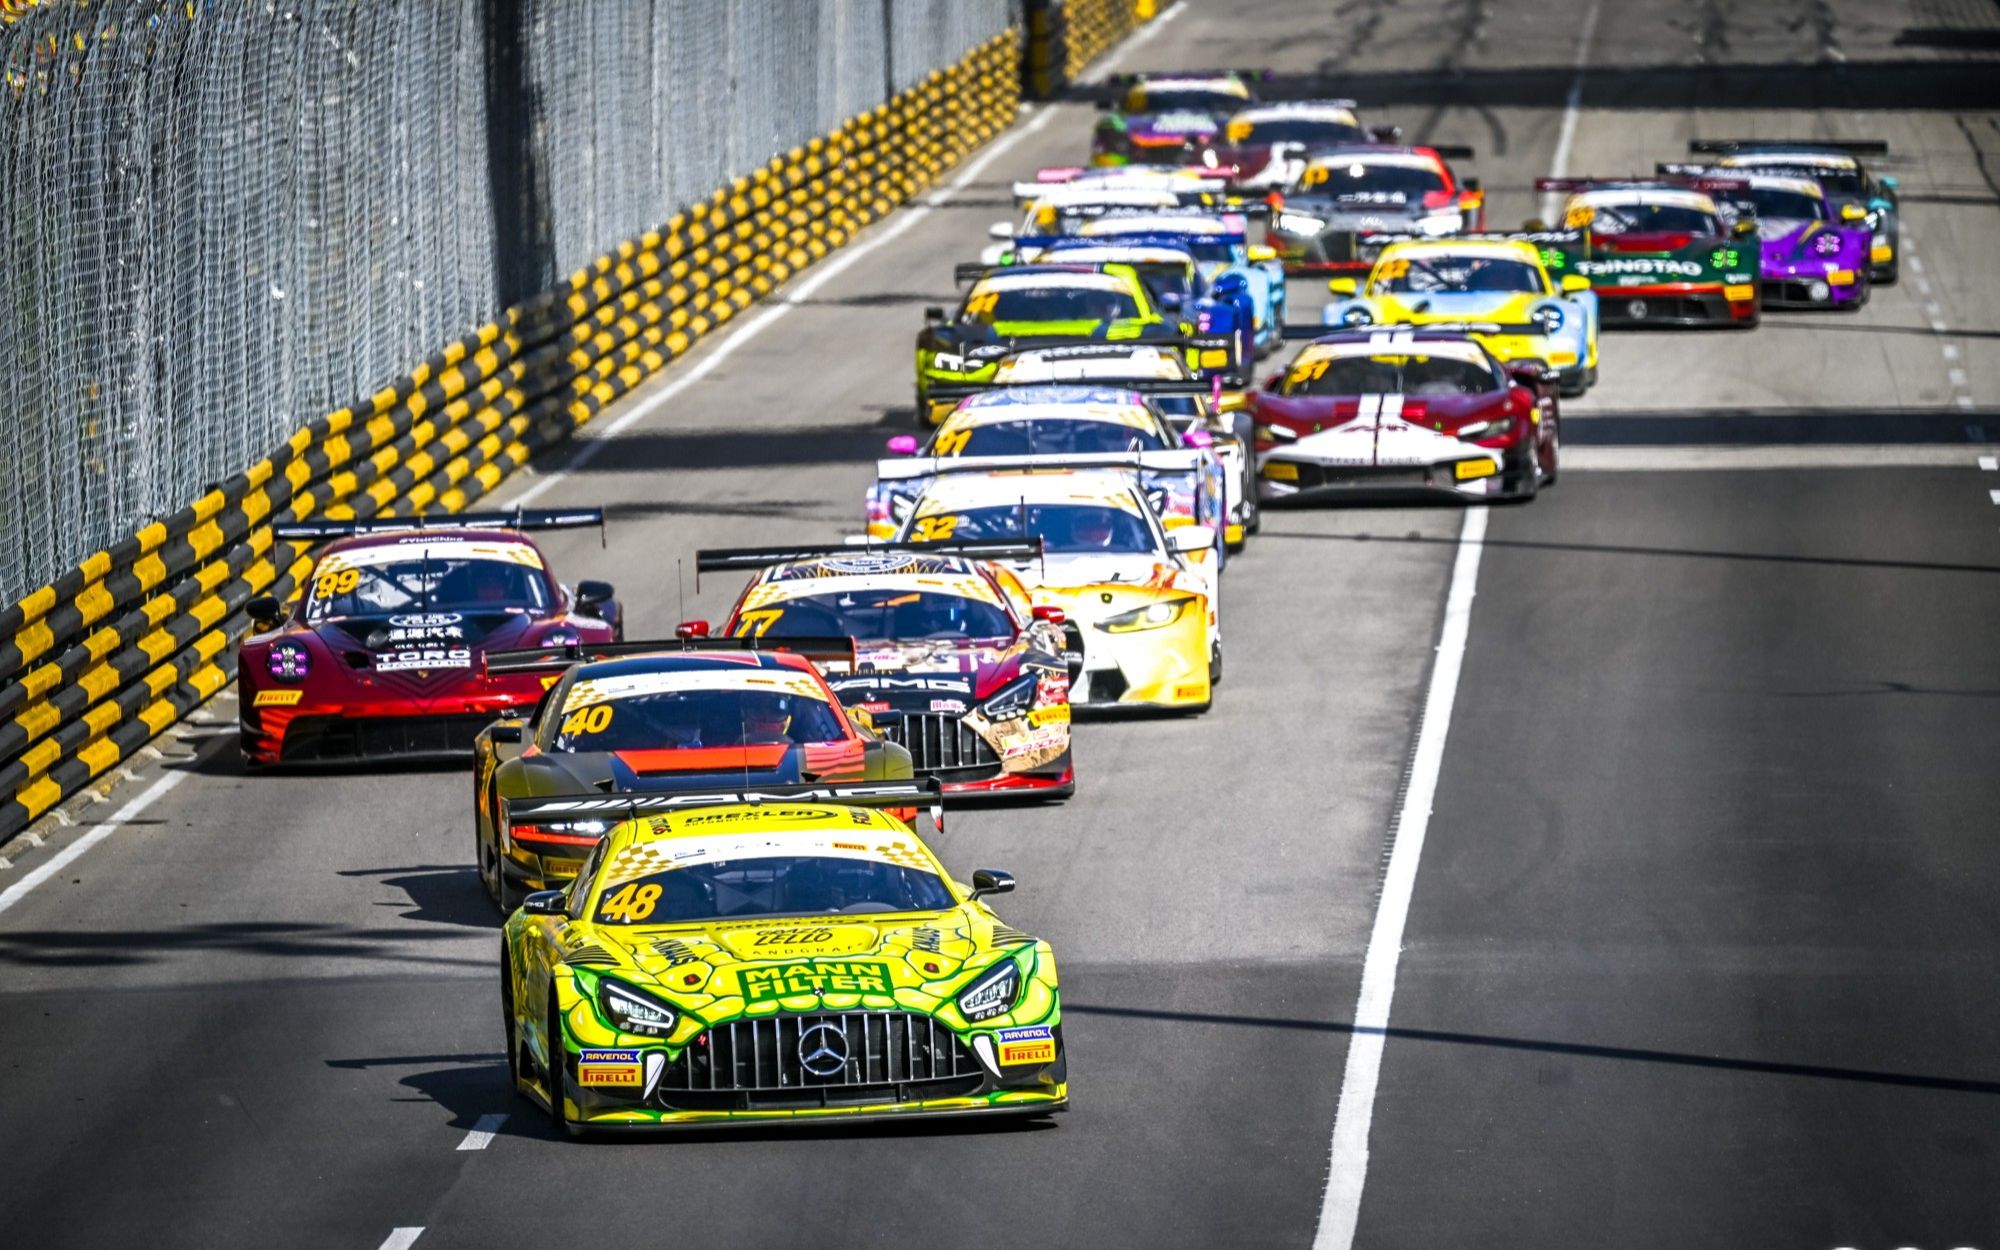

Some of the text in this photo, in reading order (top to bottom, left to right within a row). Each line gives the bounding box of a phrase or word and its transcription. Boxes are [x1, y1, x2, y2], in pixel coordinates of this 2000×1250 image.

[911, 515, 957, 541] 32
[316, 568, 359, 598] 99
[736, 609, 784, 637] 77
[376, 650, 471, 662] TORO
[829, 678, 971, 693] AMG
[561, 705, 613, 736] 40
[684, 817, 760, 827] AUTOMOTIVE
[685, 811, 813, 823] DREXLER
[601, 883, 663, 920] 48
[753, 931, 833, 946] LELLO
[745, 963, 882, 983] MANN
[747, 974, 887, 999] FILTER
[1004, 1029, 1047, 1040] RAVENOL
[585, 1052, 634, 1061] RAVENOL
[1004, 1044, 1051, 1061] PIRELLI
[582, 1068, 636, 1083] PIRELLI
